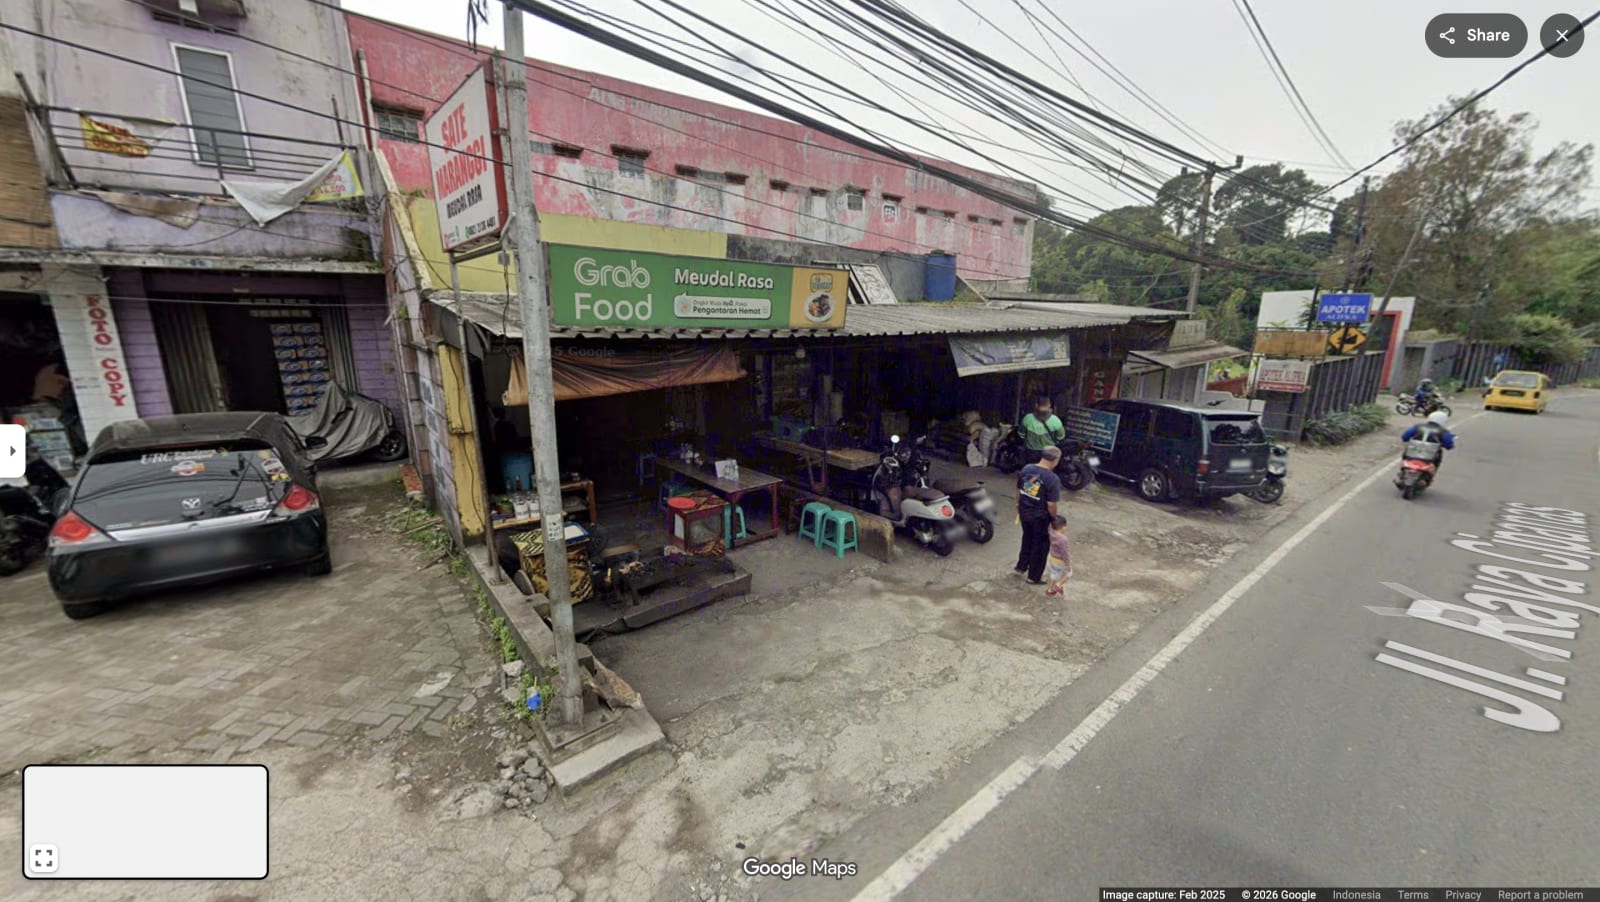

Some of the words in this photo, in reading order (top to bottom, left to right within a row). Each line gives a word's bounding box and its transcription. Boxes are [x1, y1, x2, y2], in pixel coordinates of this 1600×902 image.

[441, 102, 468, 155] SATE
[435, 135, 488, 201] MARANGGI
[574, 256, 651, 289] Grab
[674, 267, 735, 288] Meudal
[737, 273, 774, 290] Rasa
[574, 292, 653, 321] Food
[692, 305, 738, 315] Pengantaran
[738, 307, 761, 315] Hemat
[1321, 304, 1367, 314] APOTEK
[86, 296, 113, 346] FOTO
[100, 358, 127, 407] COPY
